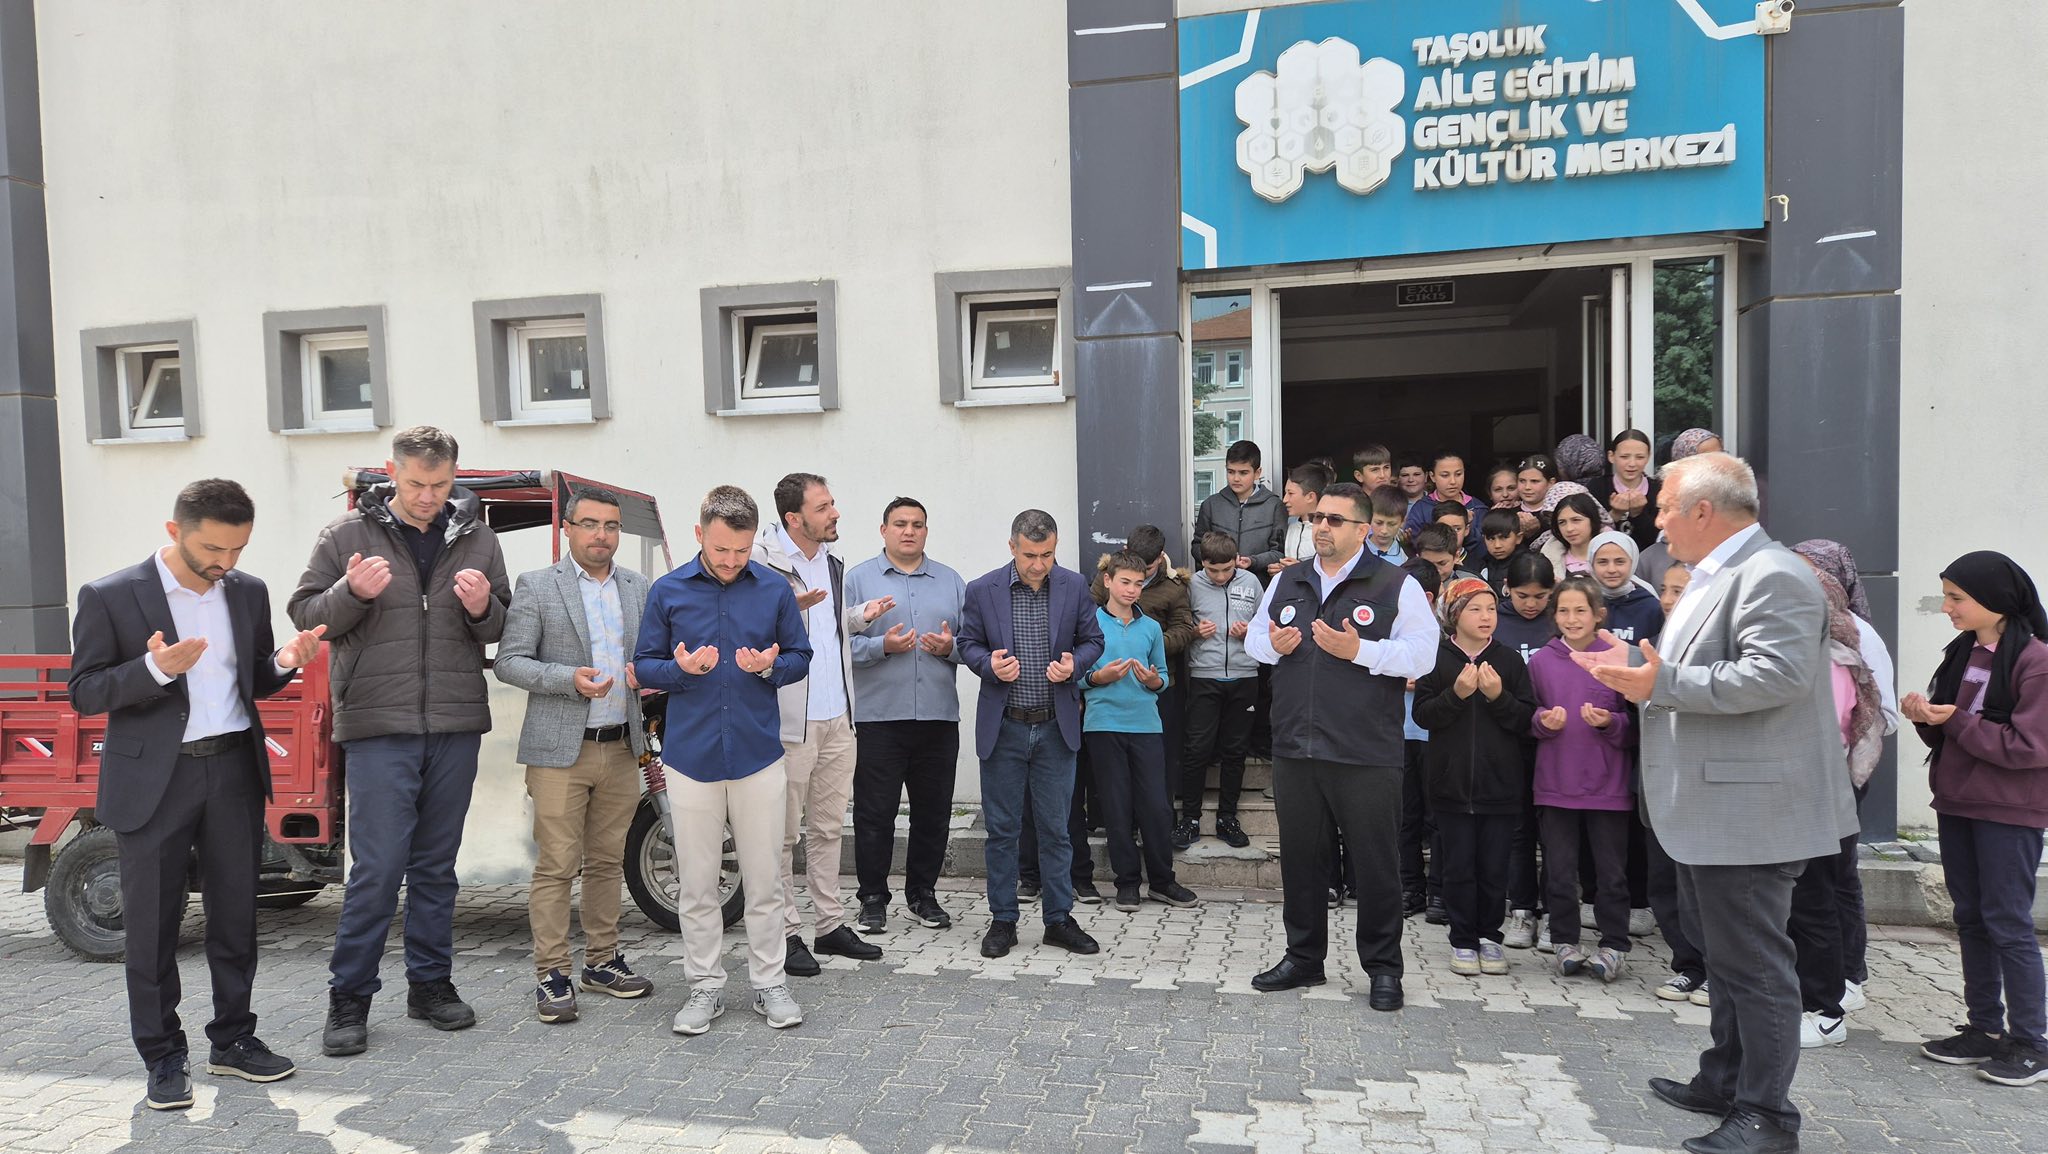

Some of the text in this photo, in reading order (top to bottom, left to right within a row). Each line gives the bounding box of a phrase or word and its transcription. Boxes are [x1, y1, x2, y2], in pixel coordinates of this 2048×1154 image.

[1412, 25, 1547, 67] TAŞOLUK
[1414, 52, 1636, 111] AİLE EĞİTİM
[1413, 99, 1629, 149] GENÇLİK VE
[1414, 123, 1737, 191] KÜLTÜR MERKEZİ
[1407, 284, 1443, 294] EXIT
